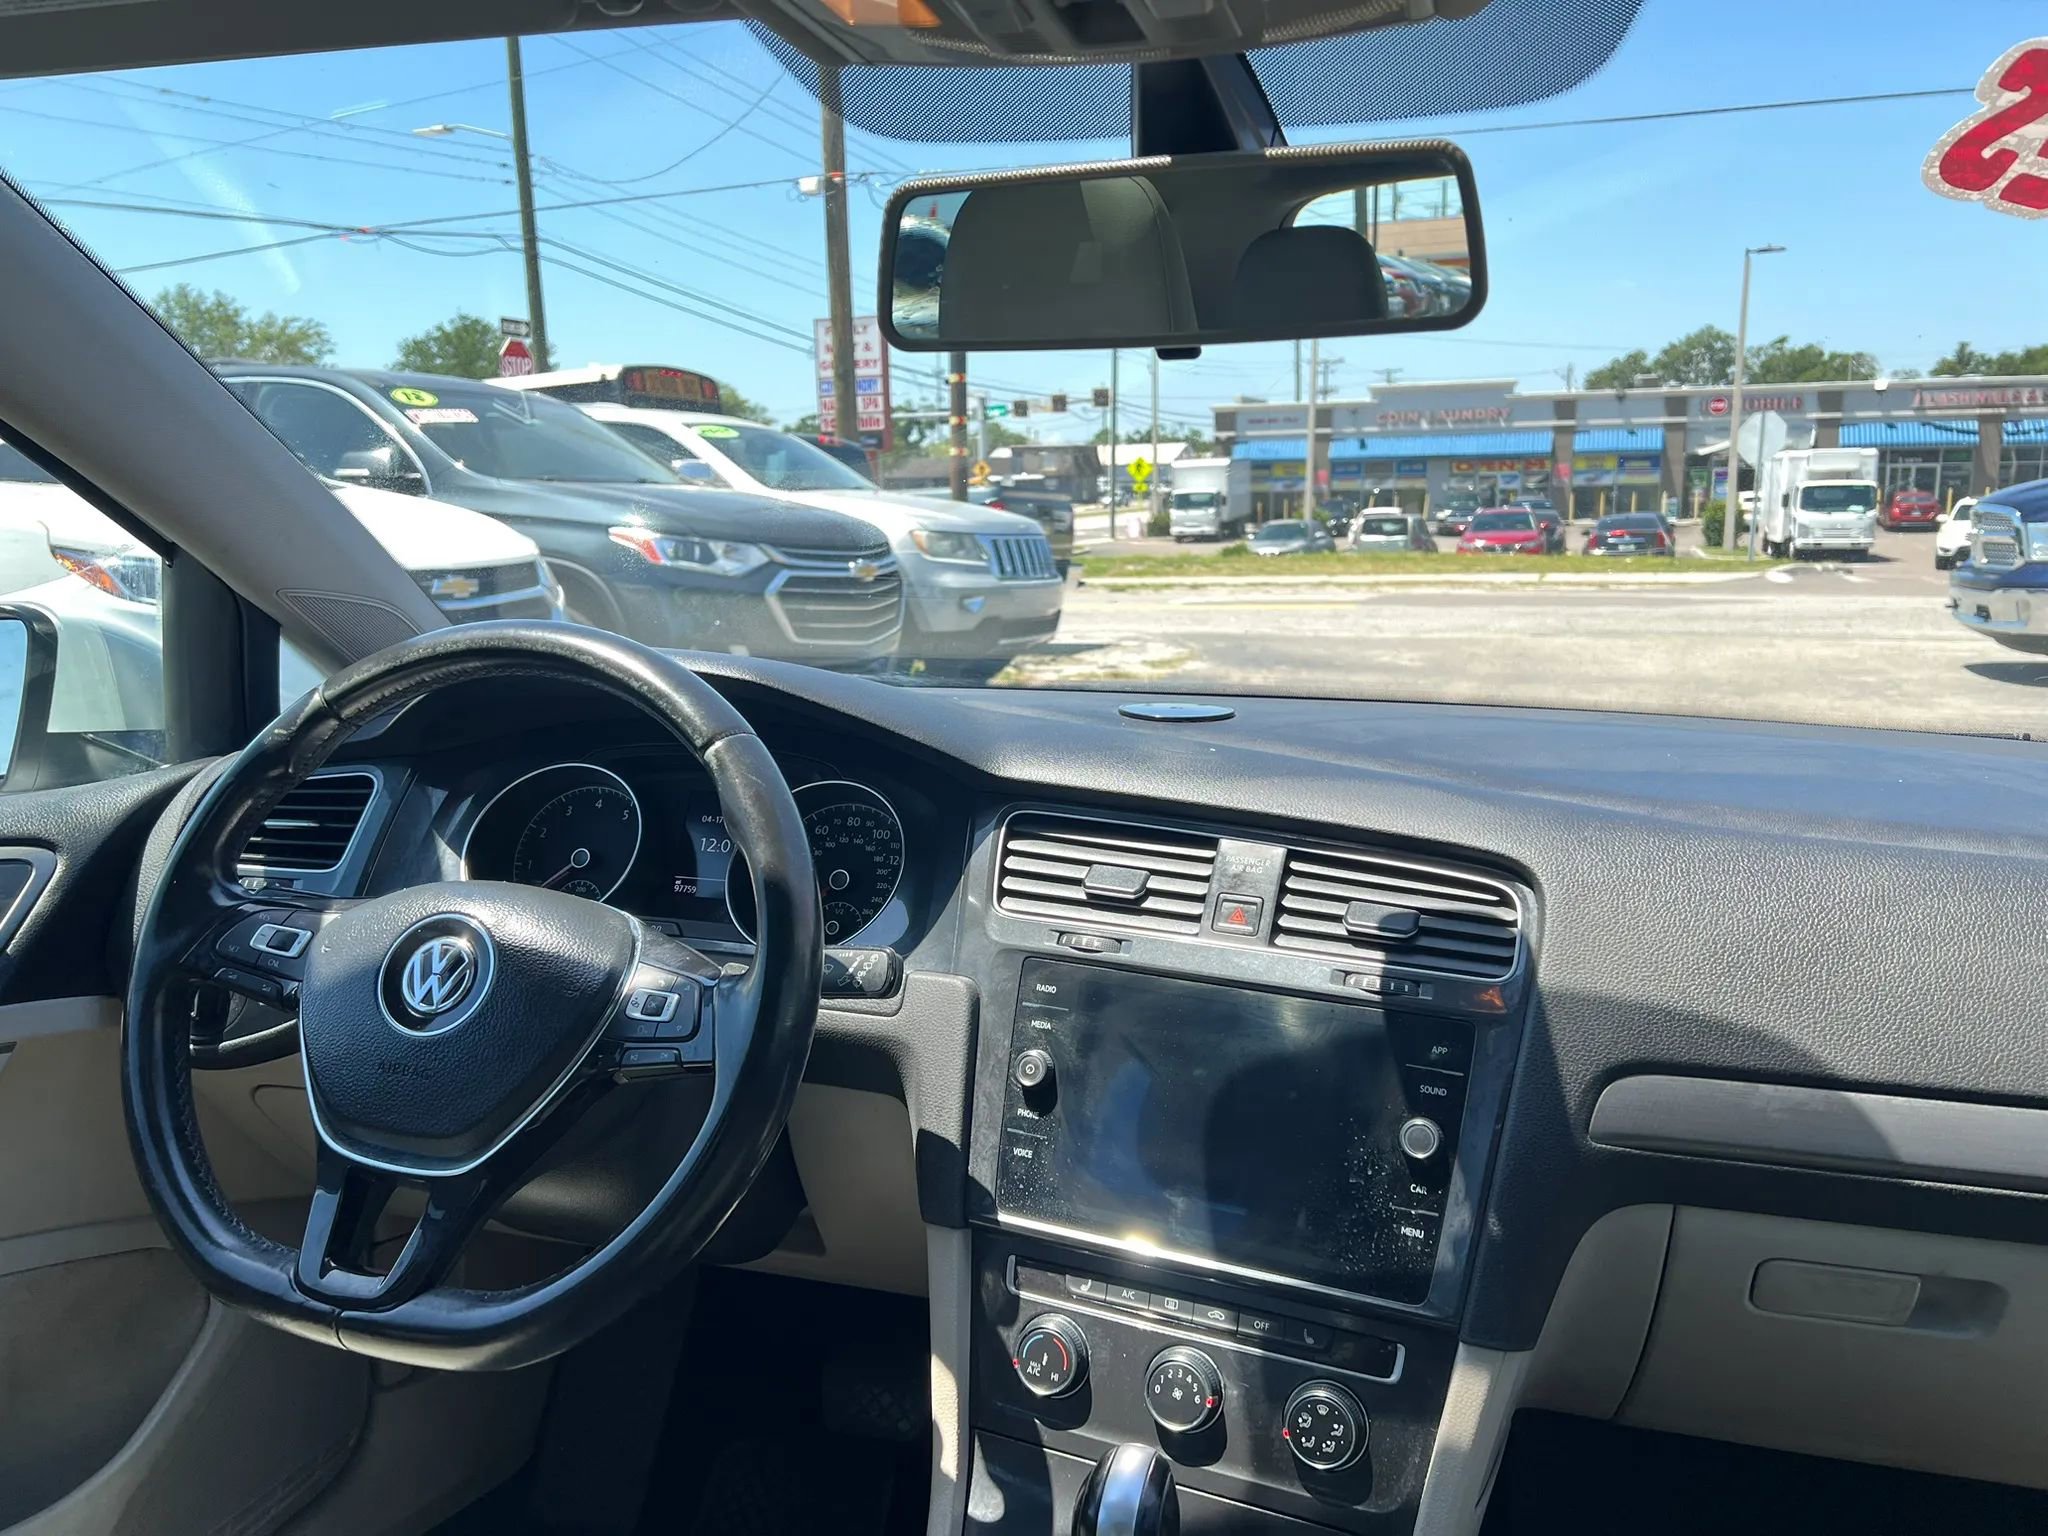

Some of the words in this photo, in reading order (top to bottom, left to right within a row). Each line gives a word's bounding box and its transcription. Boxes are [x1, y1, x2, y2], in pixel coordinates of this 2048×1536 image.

[502, 356, 532, 376] STOP
[1376, 411, 1420, 423] COIN
[595, 800, 602, 808] 4
[566, 806, 573, 816] 3
[622, 810, 630, 820] 5
[846, 816, 861, 826] 80
[540, 828, 547, 838] 2
[815, 826, 829, 836] 60
[872, 830, 890, 840] 100
[700, 838, 731, 852] 12:0
[888, 856, 900, 866] 12
[1226, 856, 1271, 866] PASSENGER
[1231, 864, 1244, 872] AIR
[1246, 866, 1263, 874] BAG
[674, 884, 697, 894] 97759
[1036, 983, 1056, 994] RADIO
[1030, 1020, 1052, 1030] MEDIA
[1431, 1045, 1448, 1054] APP
[1420, 1084, 1447, 1096] SOUND
[1017, 1108, 1040, 1120] PHONE
[1013, 1147, 1034, 1158] VOICE
[1410, 1184, 1428, 1195] CAR
[1400, 1226, 1424, 1239] MENU
[1122, 1290, 1136, 1300] A/C
[1254, 1320, 1270, 1331] OFF
[1026, 1365, 1041, 1377] A/C
[1168, 1369, 1174, 1378] 2
[1178, 1368, 1183, 1378] 3
[1050, 1372, 1060, 1382] HI
[1160, 1374, 1164, 1384] 1
[1186, 1374, 1192, 1384] 4
[1154, 1384, 1161, 1394] 0
[1192, 1383, 1198, 1392] 5
[1194, 1394, 1201, 1404] 6
